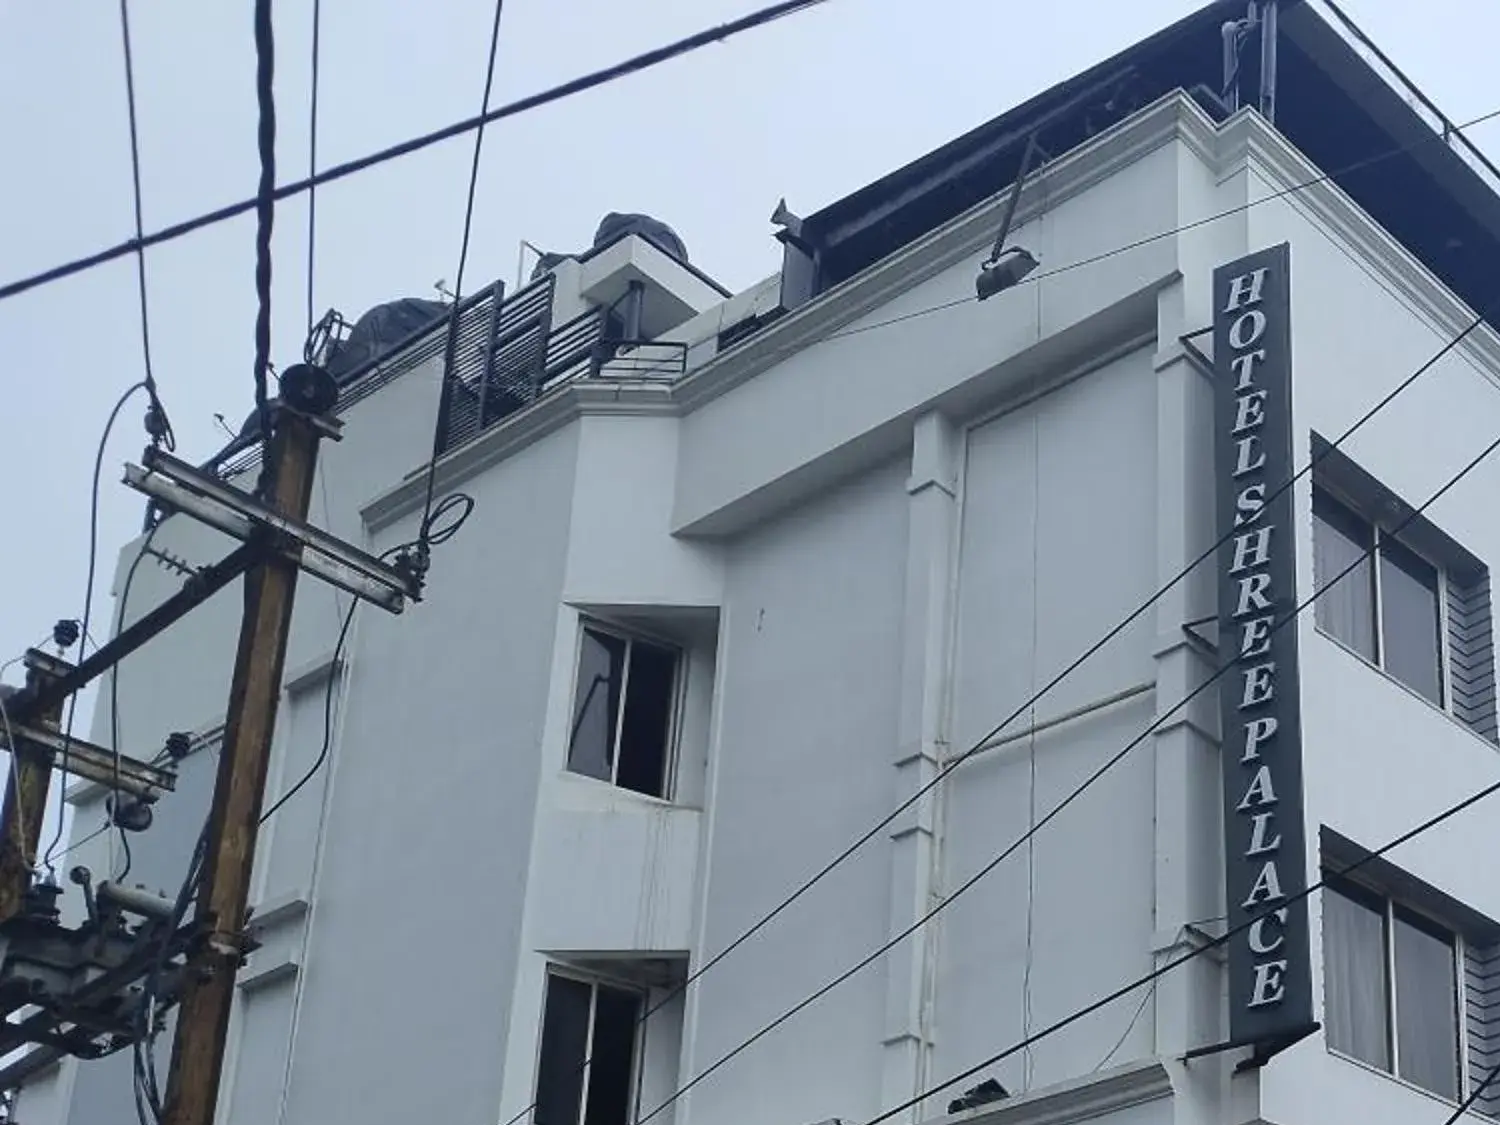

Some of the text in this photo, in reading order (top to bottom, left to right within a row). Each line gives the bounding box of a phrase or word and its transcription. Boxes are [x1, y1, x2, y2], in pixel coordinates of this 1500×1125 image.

[1222, 267, 1288, 1009] HOTEL SHREE PALACE
